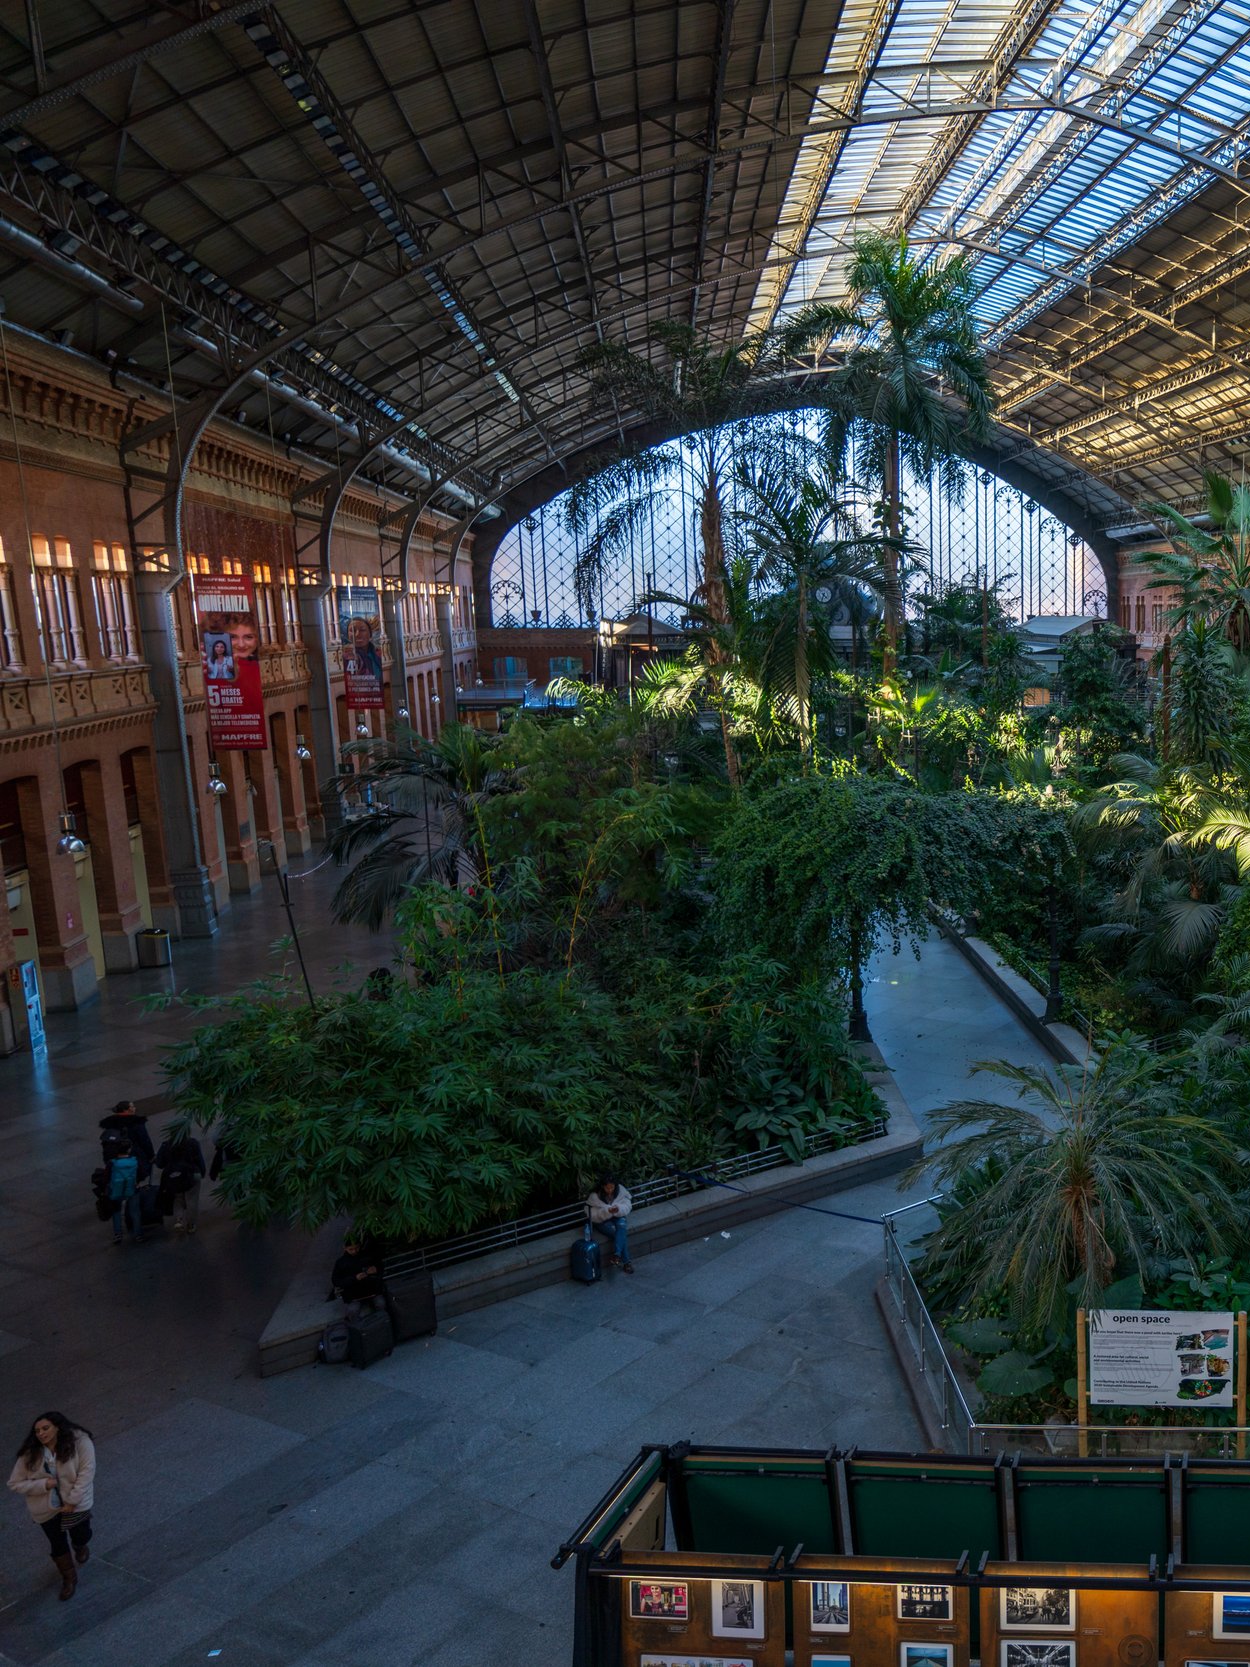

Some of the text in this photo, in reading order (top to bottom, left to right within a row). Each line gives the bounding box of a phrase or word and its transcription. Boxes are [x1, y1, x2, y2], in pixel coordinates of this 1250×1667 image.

[198, 594, 250, 612] CONFIANZA
[207, 685, 220, 707] 5
[220, 688, 241, 696] MESES
[1113, 1316, 1170, 1324] open space
